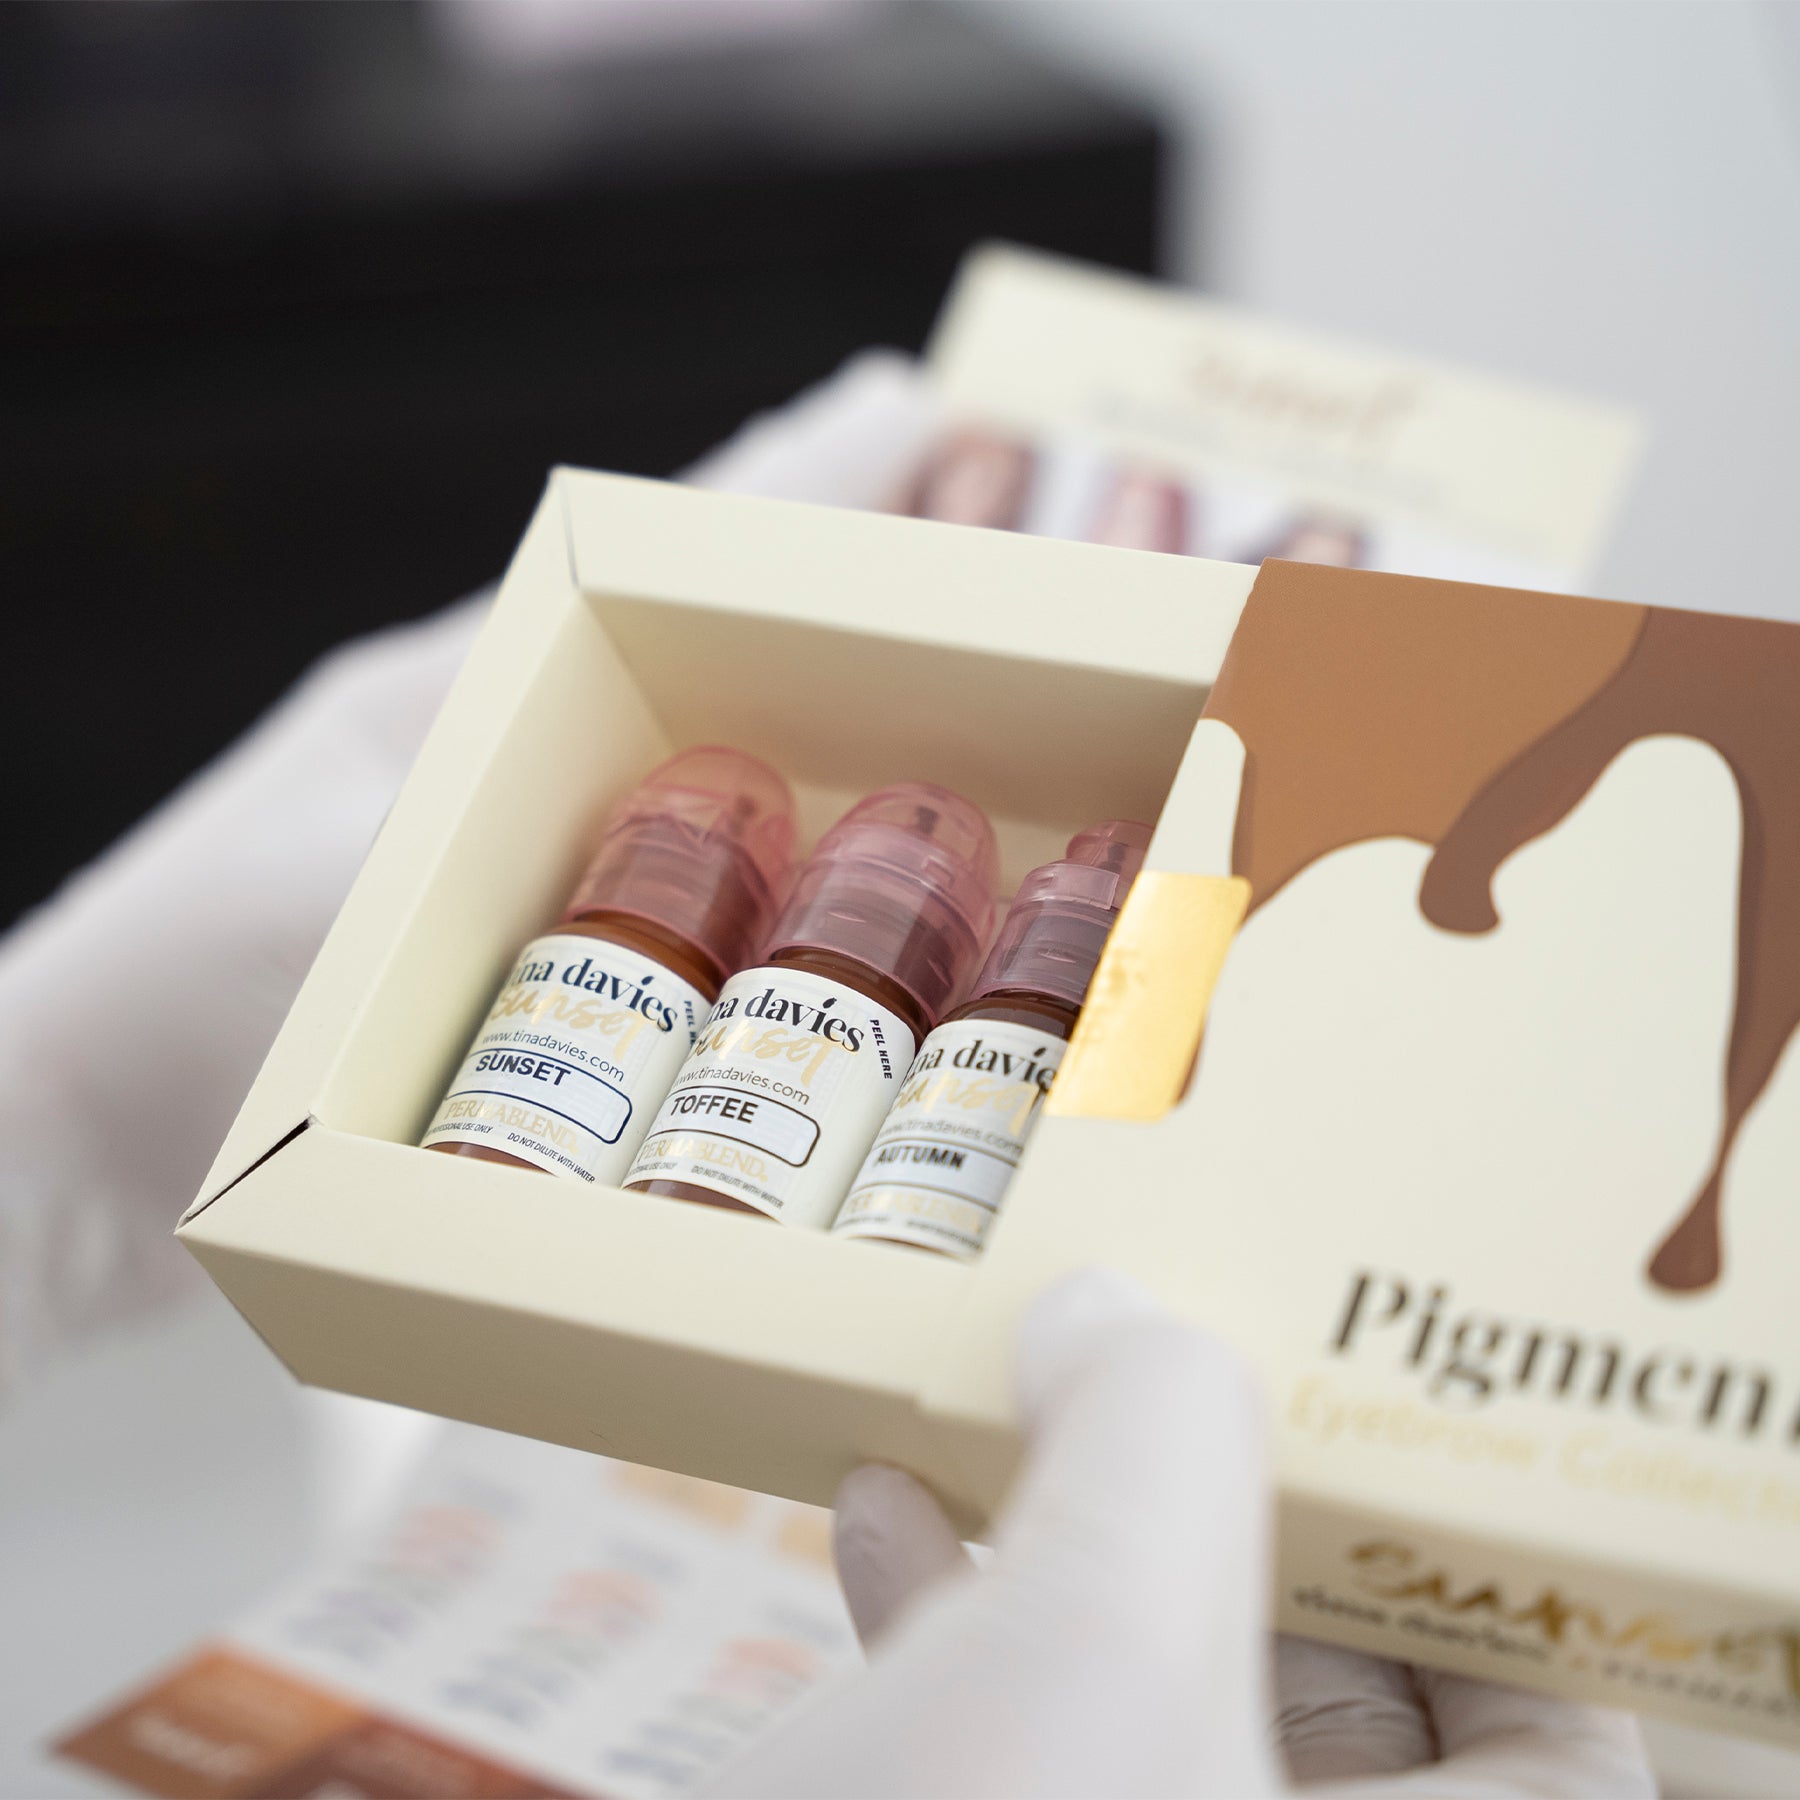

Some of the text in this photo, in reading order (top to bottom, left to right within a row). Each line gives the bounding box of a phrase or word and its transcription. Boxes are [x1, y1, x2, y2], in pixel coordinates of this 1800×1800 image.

[562, 958, 677, 1032] davies
[744, 988, 865, 1052] davies
[476, 1055, 571, 1087] SUNSET
[483, 1030, 625, 1082] www.tinadavies.com
[870, 1019, 893, 1079] PEEL HERE
[953, 1040, 1058, 1092] davie
[670, 1095, 758, 1123] TOFFEE
[507, 1132, 518, 1142] DO
[517, 1136, 534, 1149] NOT
[557, 1155, 575, 1170] WITH
[573, 1164, 595, 1183] WATER
[876, 1145, 967, 1170] AUTUMN
